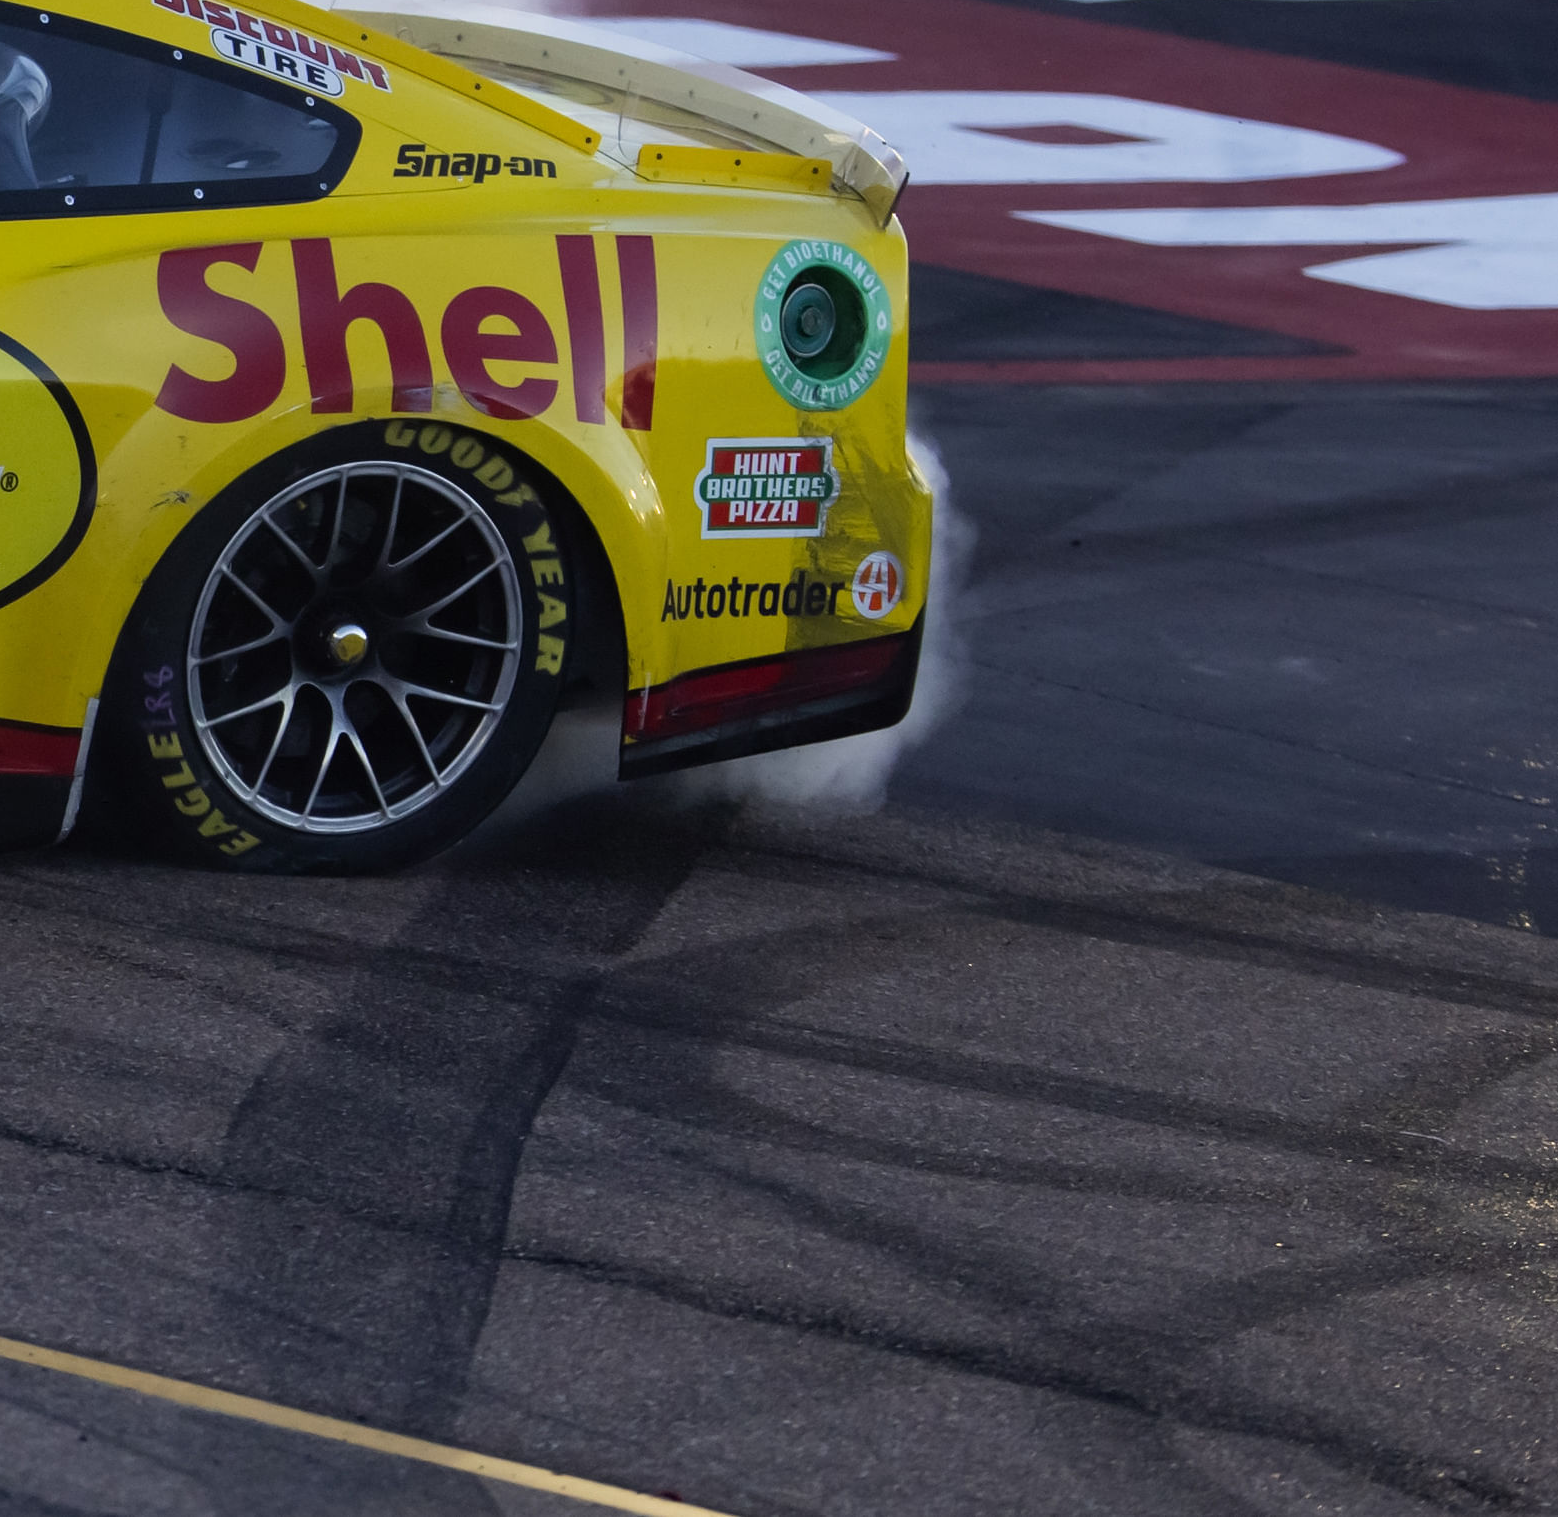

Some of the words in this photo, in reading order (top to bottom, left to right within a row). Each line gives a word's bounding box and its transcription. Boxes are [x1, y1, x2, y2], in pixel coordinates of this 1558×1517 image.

[224, 33, 329, 89] TIRE
[393, 143, 557, 183] Snap-on
[763, 263, 787, 300] GET
[783, 241, 882, 303] BIOETHANOL
[156, 235, 658, 431] Shell
[706, 477, 826, 500] BROTHERS
[734, 452, 801, 476] HUNT
[728, 500, 798, 523] PIZZA
[661, 569, 846, 623] Autotrader
[148, 731, 262, 857] EAGLE
